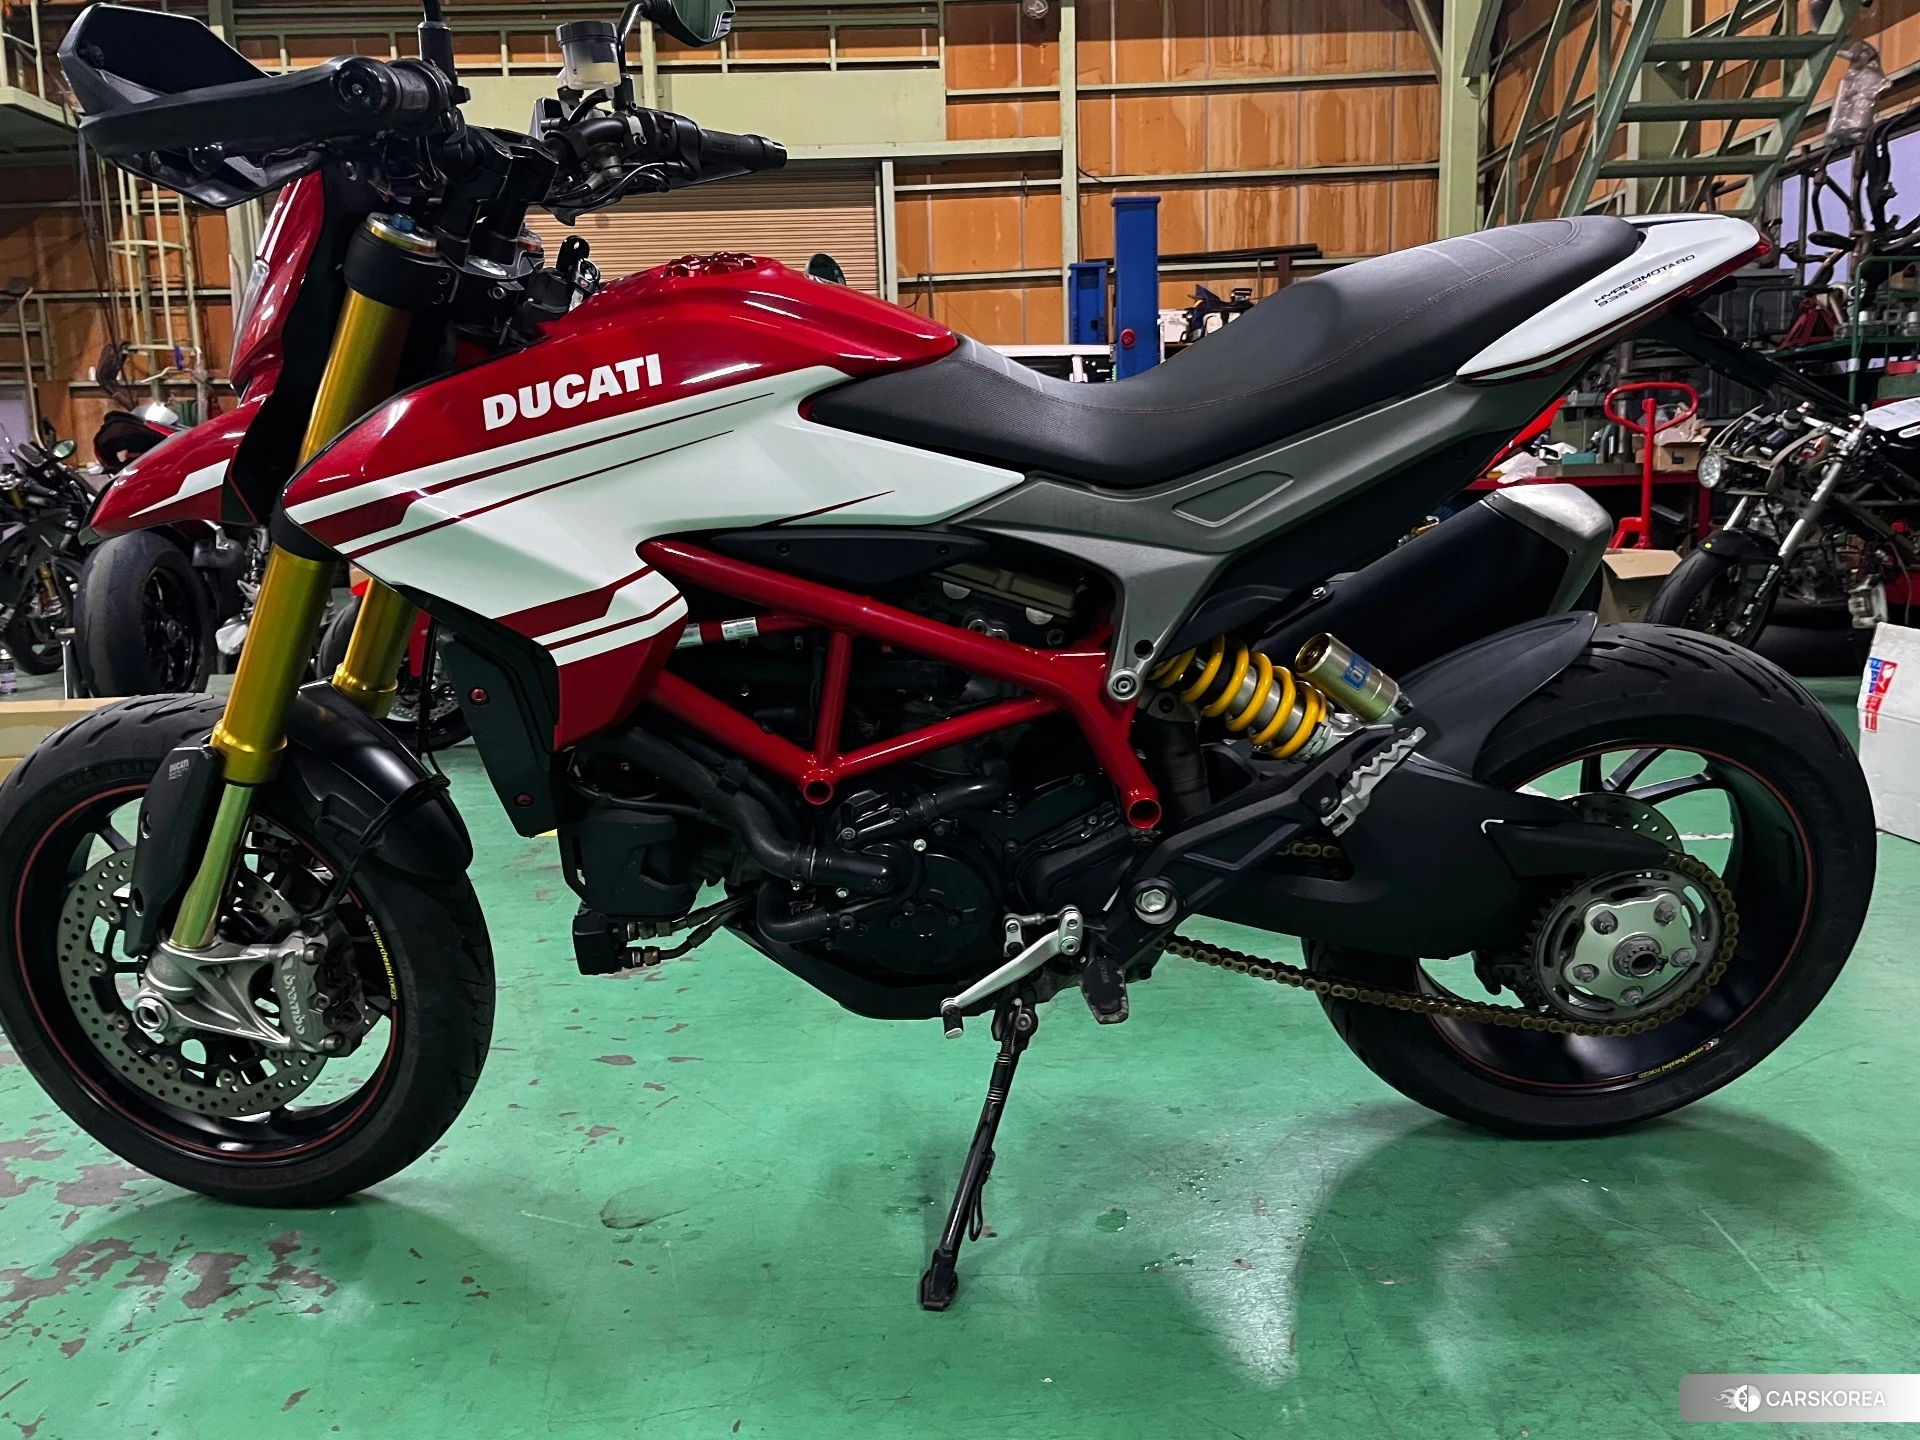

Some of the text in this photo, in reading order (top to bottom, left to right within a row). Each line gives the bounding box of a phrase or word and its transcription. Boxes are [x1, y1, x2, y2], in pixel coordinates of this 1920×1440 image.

[482, 353, 662, 431] DUCATI
[169, 759, 189, 773] DUCATI
[372, 931, 394, 977] marchesini
[283, 974, 306, 1035] brembo
